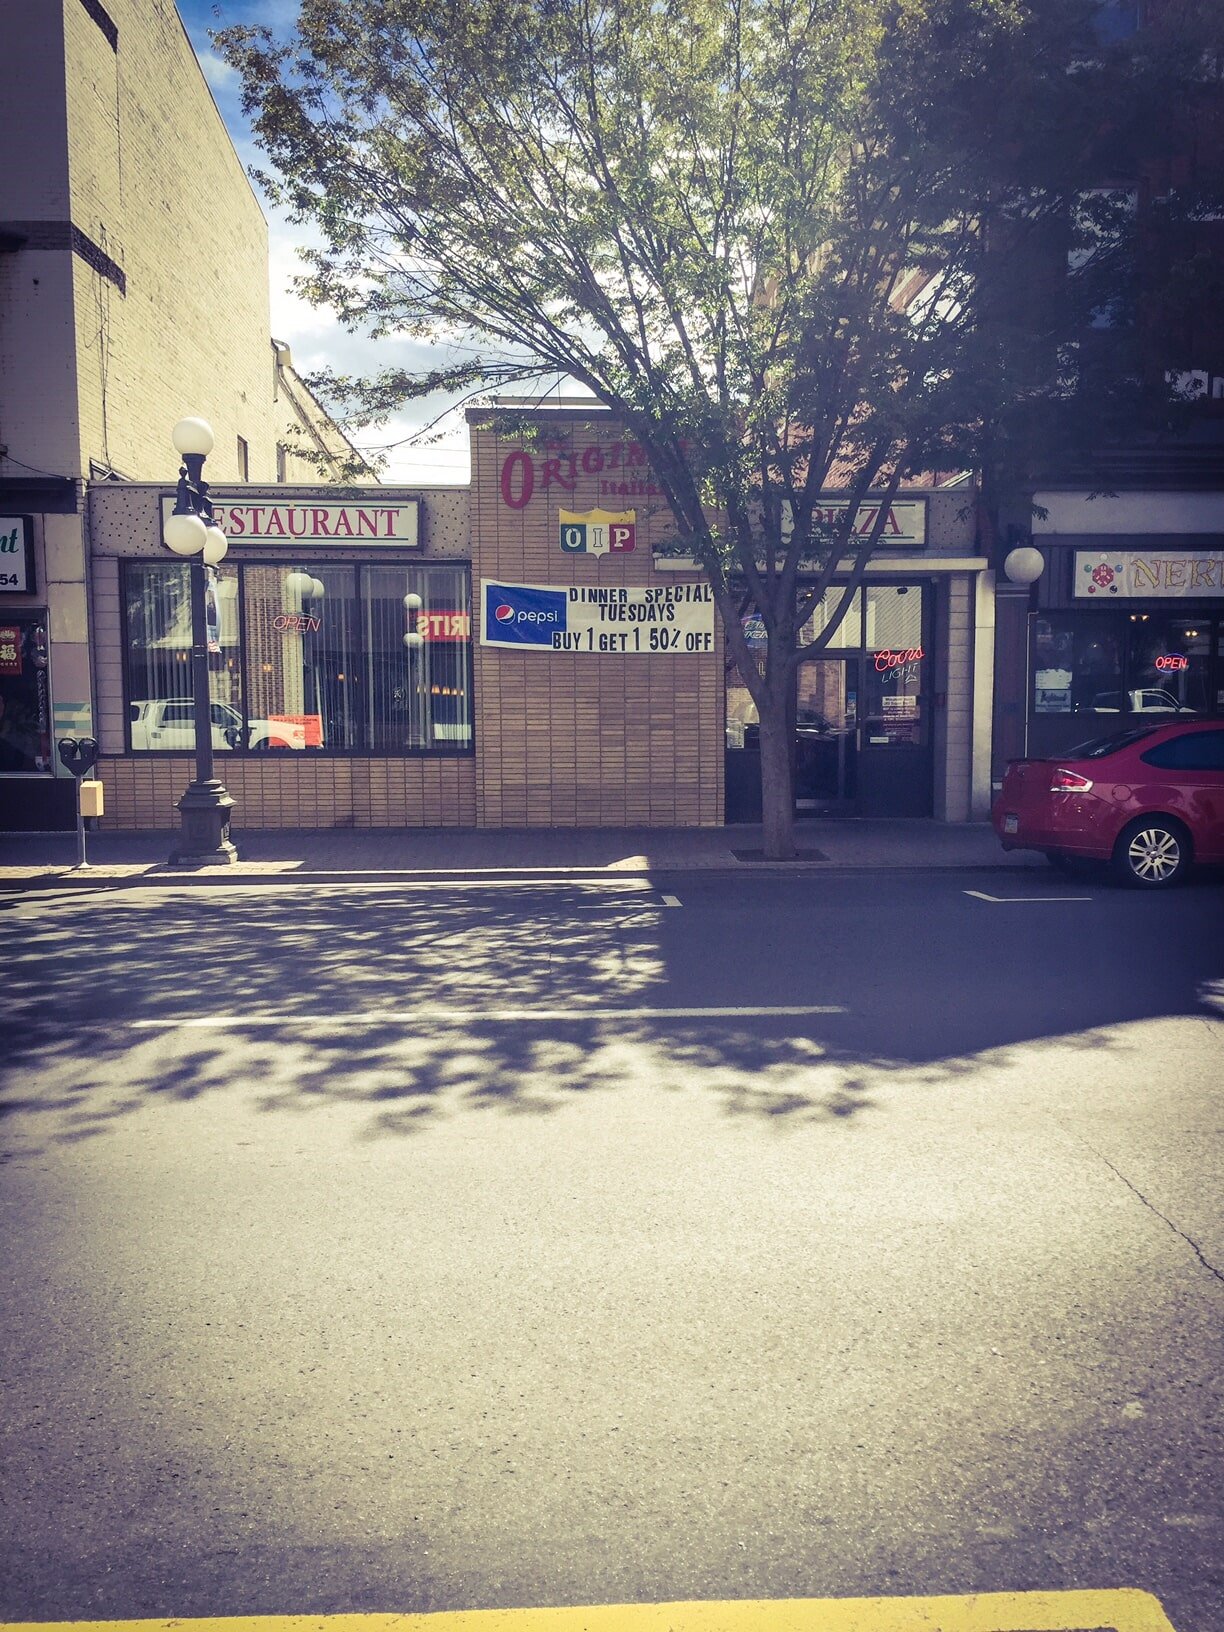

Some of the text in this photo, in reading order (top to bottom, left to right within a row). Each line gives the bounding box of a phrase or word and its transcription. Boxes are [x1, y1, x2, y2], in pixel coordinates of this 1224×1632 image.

[501, 440, 688, 509] ORIGIN
[213, 507, 400, 537] ESTAURANT
[1131, 559, 1224, 589] NER
[569, 584, 712, 604] DINNER SPECIAL
[273, 615, 321, 632] OPEN
[517, 609, 558, 624] pepsi
[599, 603, 675, 622] TUESDAYS
[552, 627, 712, 651] BUY 1 GET 1 50% OFF
[874, 645, 926, 672] Coors
[1155, 656, 1188, 669] OPEN
[881, 662, 919, 684] LIGHT
